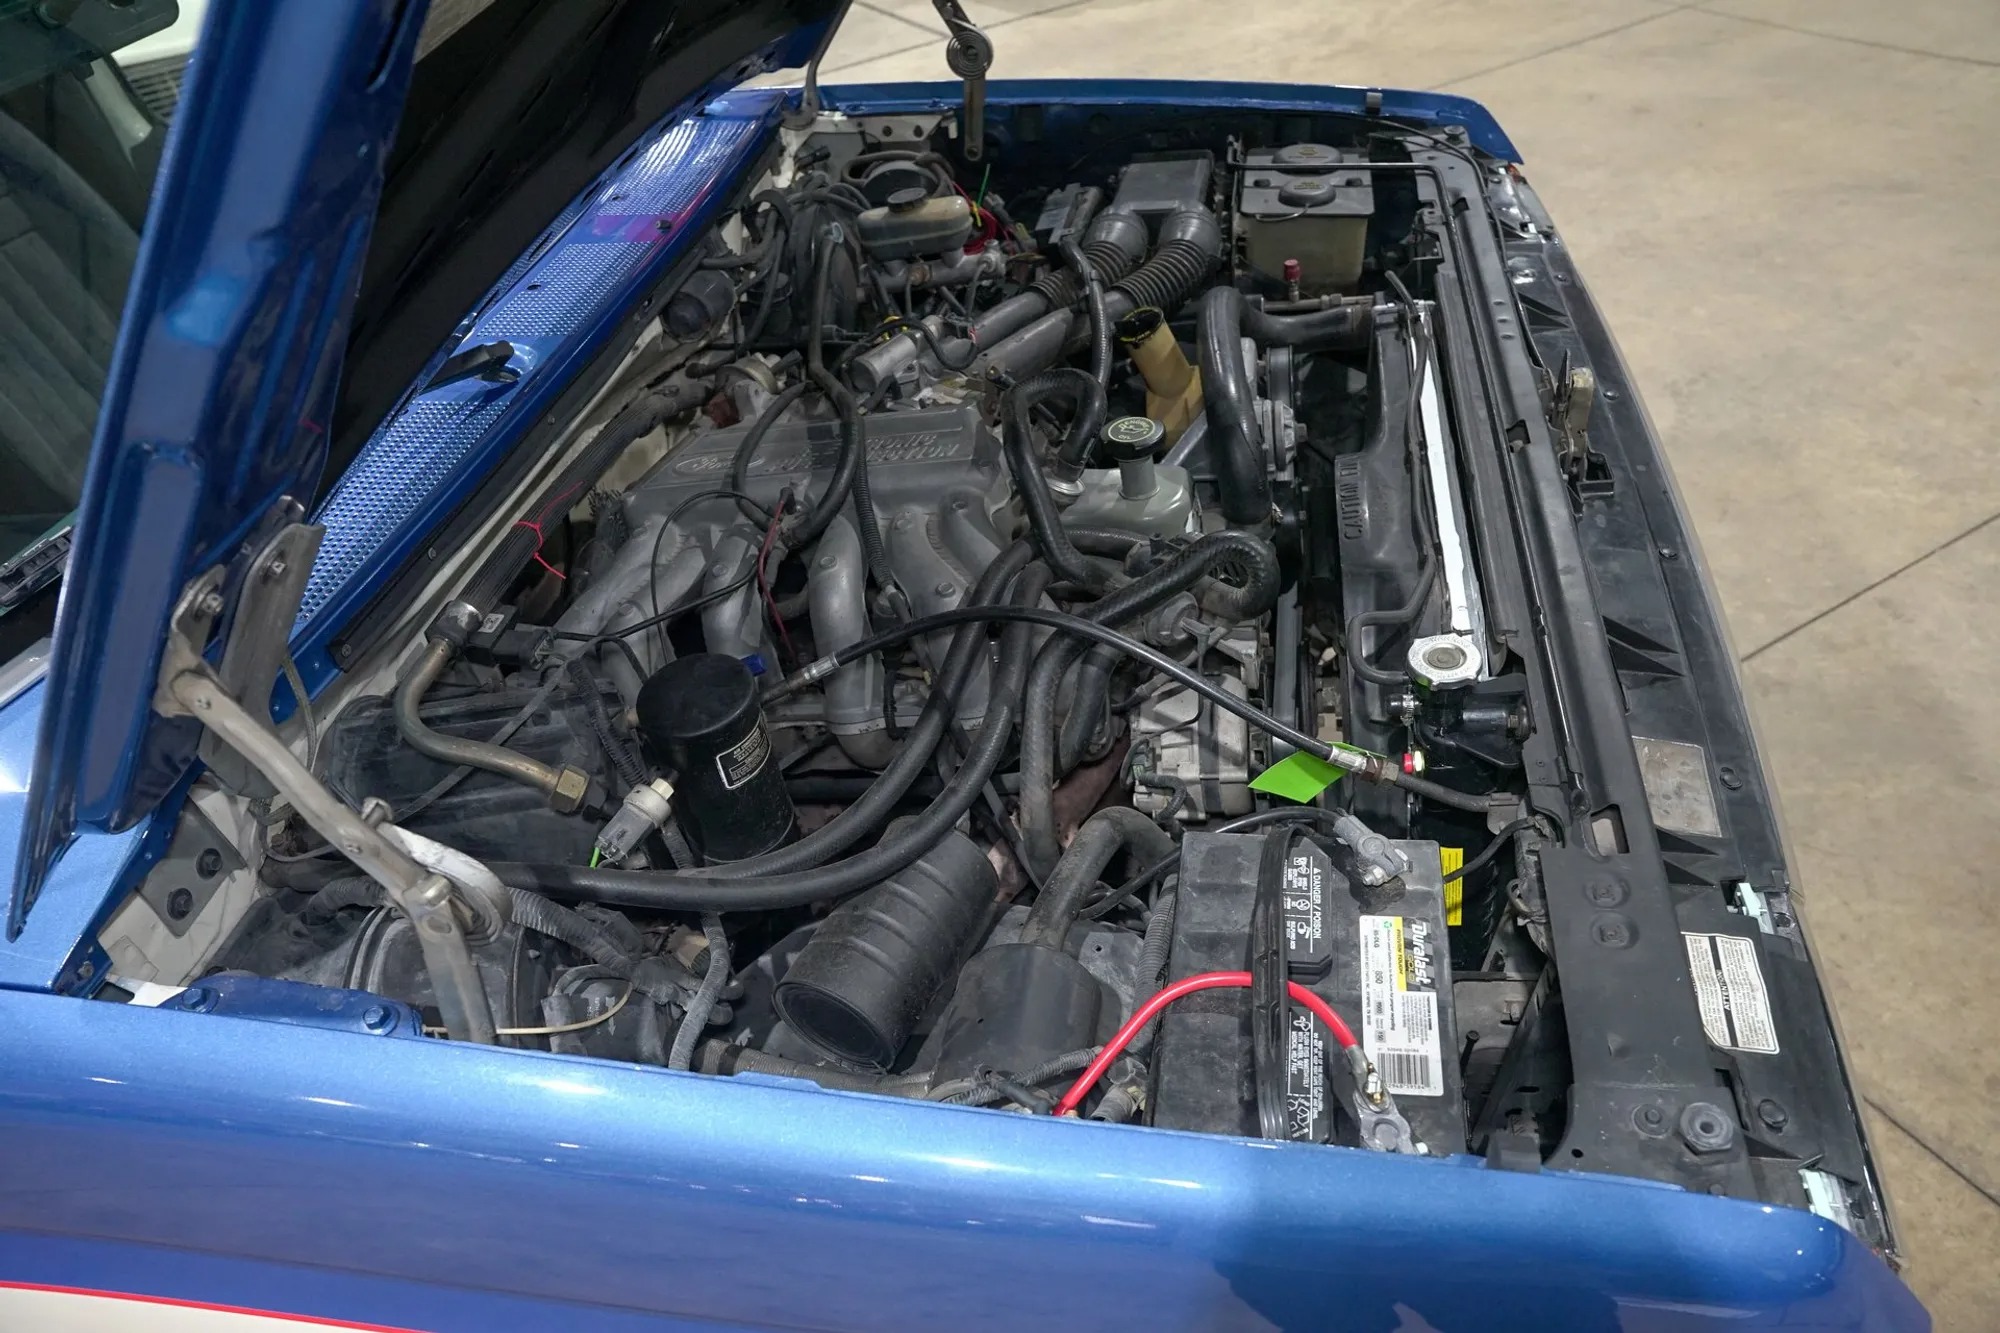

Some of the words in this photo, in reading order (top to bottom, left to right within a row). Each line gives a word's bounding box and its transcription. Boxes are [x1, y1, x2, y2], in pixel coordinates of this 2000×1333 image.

[1339, 482, 1363, 540] CAUTION
[1312, 875, 1322, 905] DANGER
[1312, 911, 1322, 939] POISON
[1407, 954, 1415, 982] GOLD
[1411, 922, 1432, 984] Duralast
